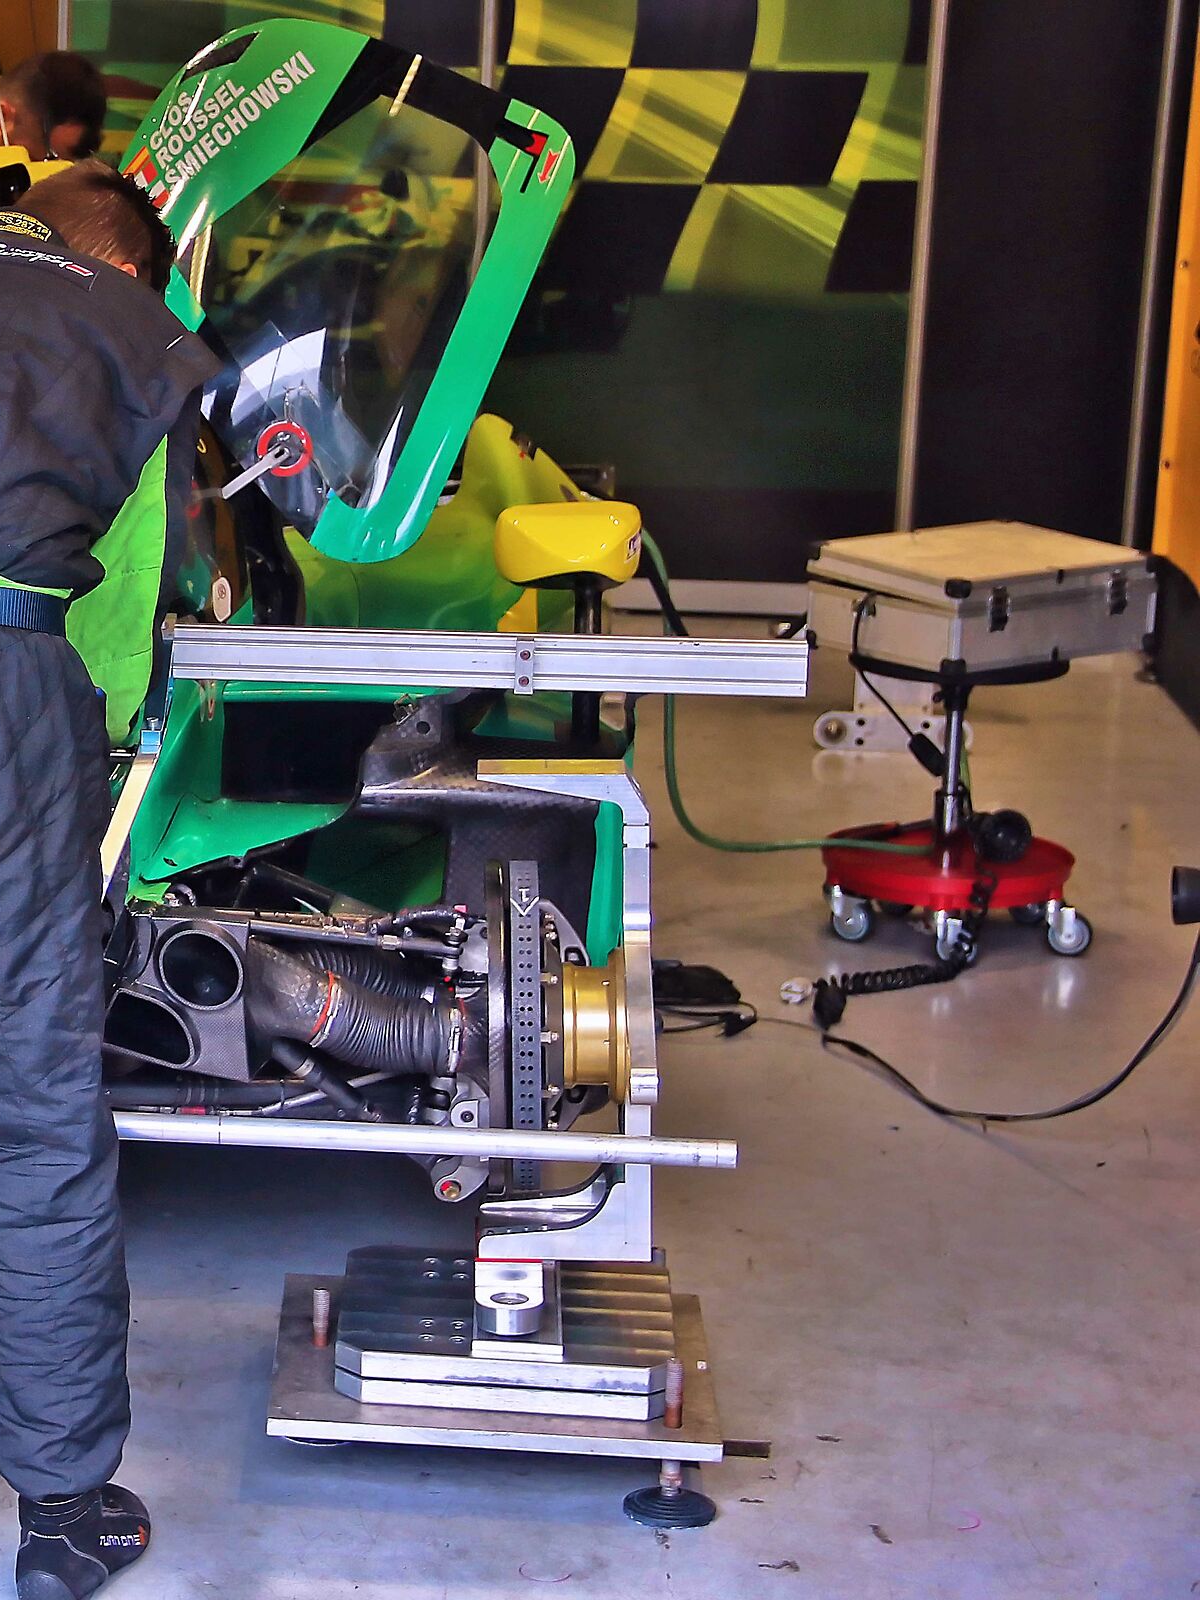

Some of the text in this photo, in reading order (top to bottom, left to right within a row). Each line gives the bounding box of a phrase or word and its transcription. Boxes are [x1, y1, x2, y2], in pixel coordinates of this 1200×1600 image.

[150, 91, 194, 150] CLOS
[155, 79, 246, 170] ROUSSEL
[164, 50, 316, 184] ŚMIECHOWSKI
